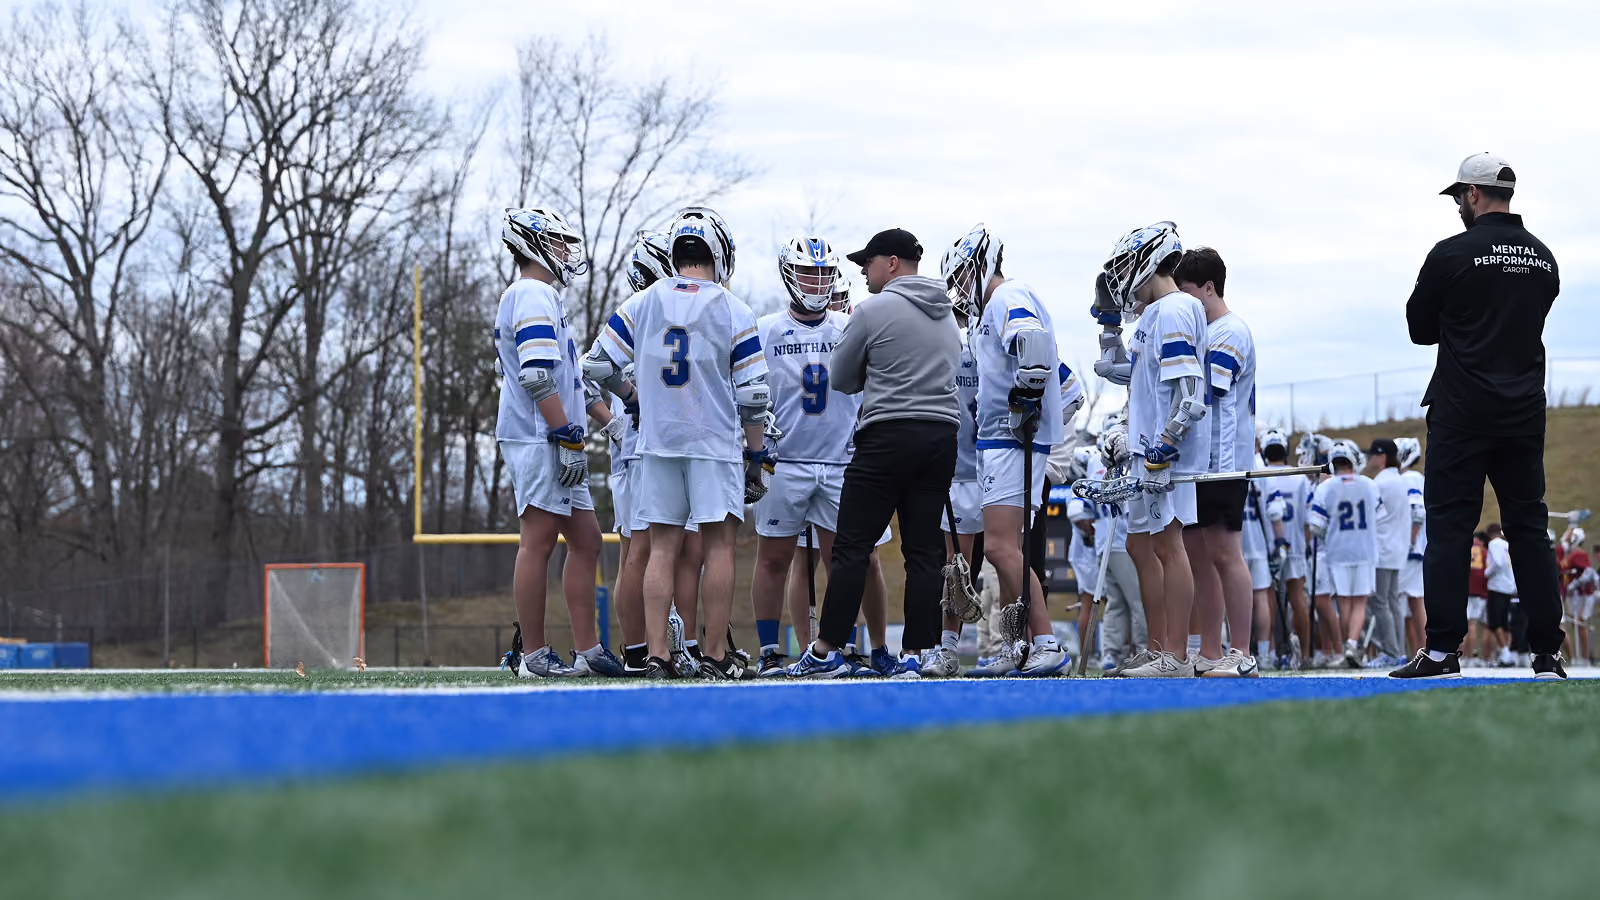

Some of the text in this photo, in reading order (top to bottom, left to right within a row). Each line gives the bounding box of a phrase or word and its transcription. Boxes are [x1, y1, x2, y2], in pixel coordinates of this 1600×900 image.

[1491, 245, 1537, 256] MENTAL
[1473, 255, 1552, 272] PERFORMANCE
[1502, 266, 1530, 274] CAROTTI
[660, 326, 691, 388] 3
[801, 362, 829, 416] 9
[1338, 499, 1367, 531] 21
